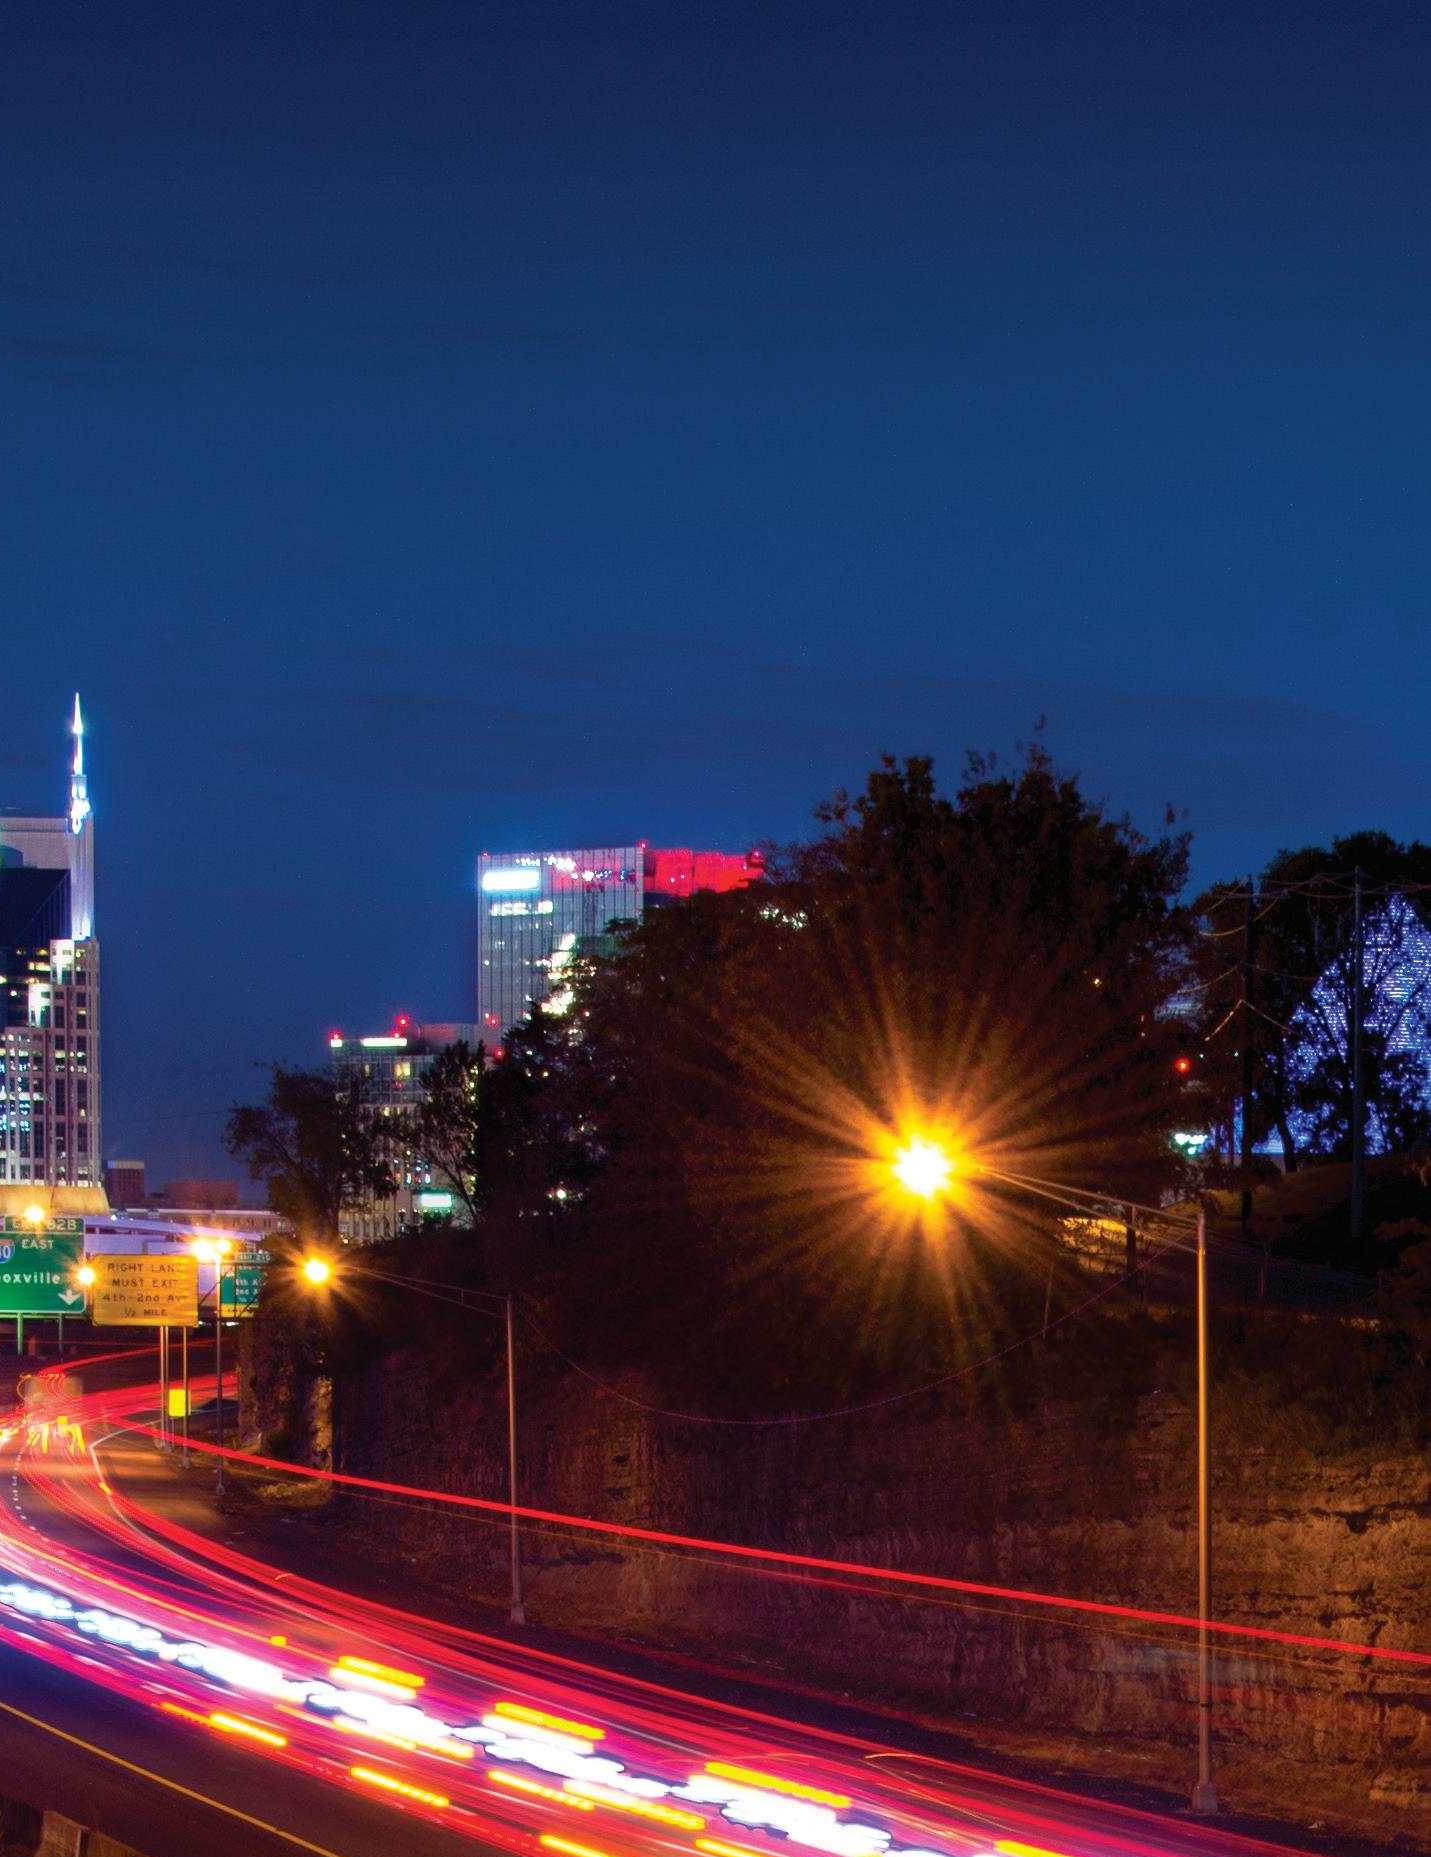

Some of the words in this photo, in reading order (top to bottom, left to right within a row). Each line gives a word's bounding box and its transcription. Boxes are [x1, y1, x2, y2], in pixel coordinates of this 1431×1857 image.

[21, 1239, 54, 1250] EAST
[107, 1262, 144, 1273] RIGHT
[111, 1279, 144, 1288] MUST
[152, 1279, 179, 1289] EXIT
[143, 1308, 168, 1317] MILE
